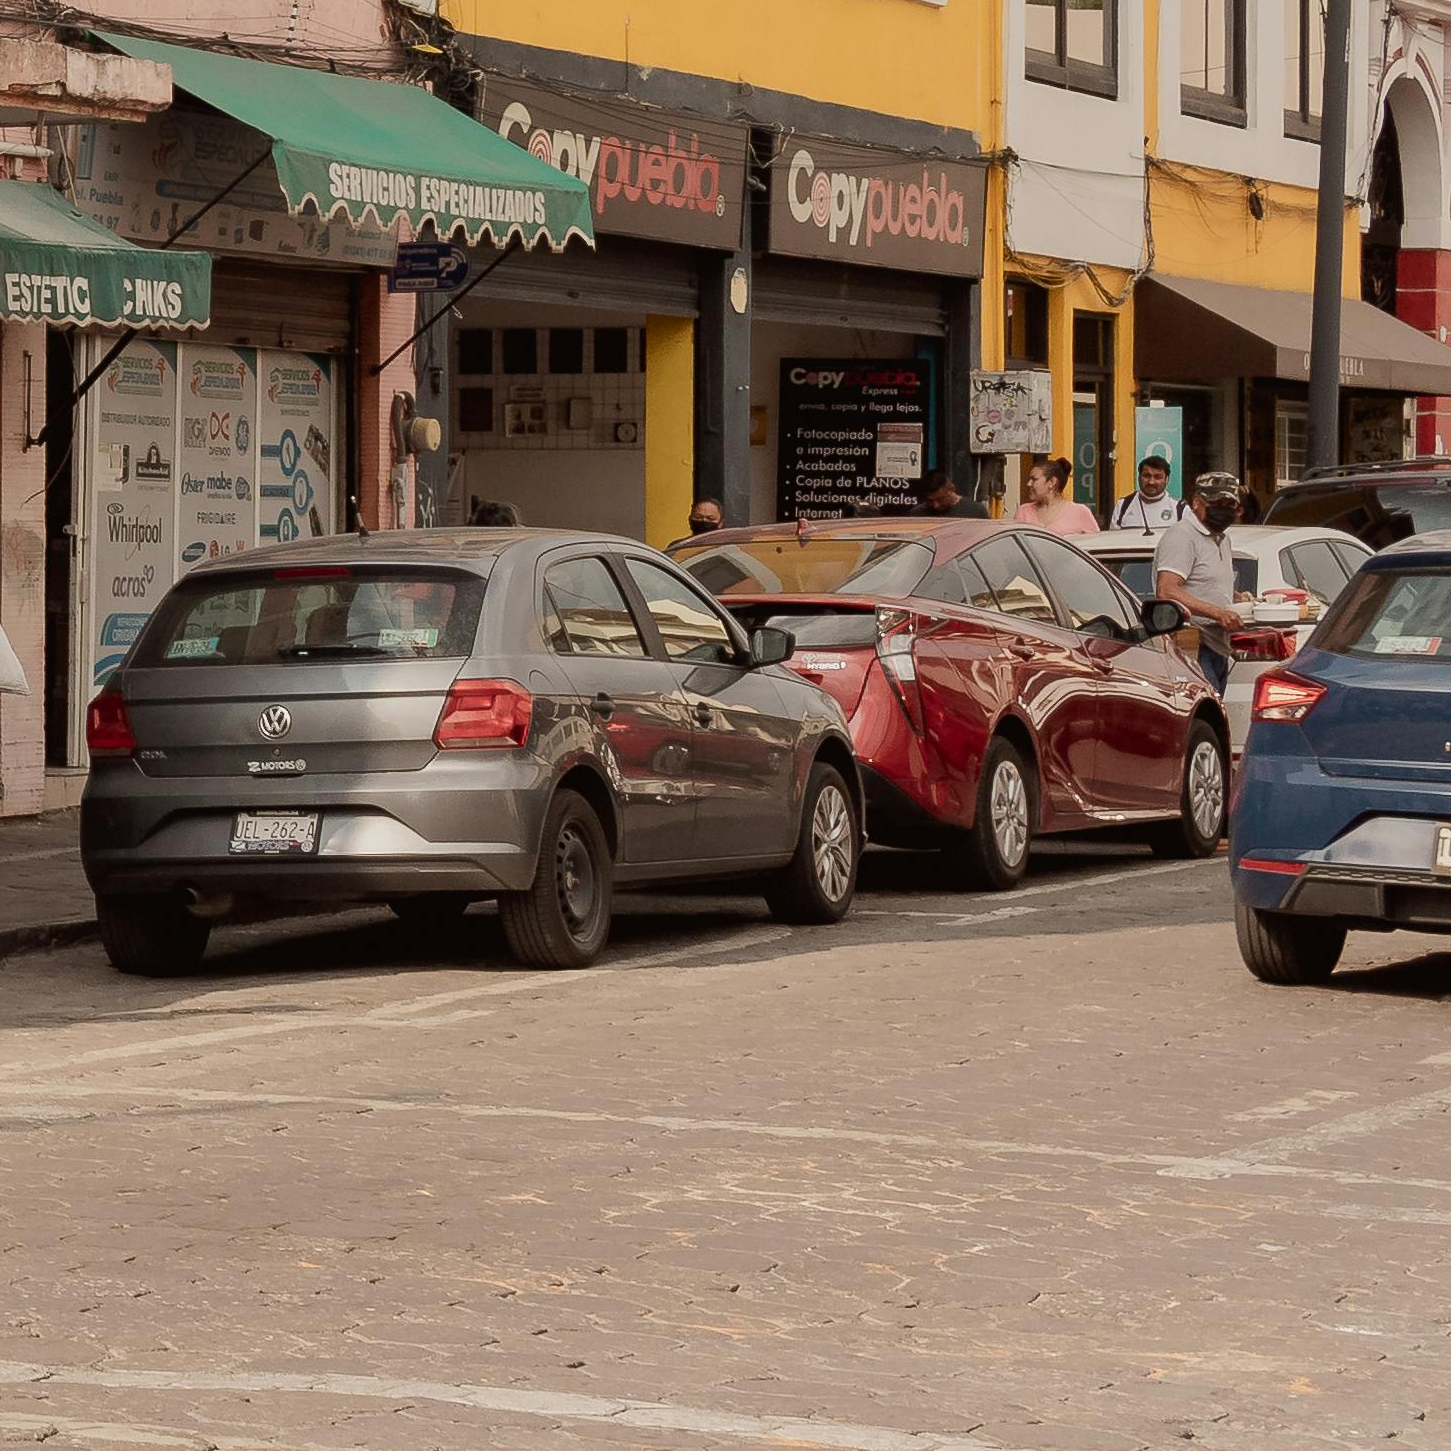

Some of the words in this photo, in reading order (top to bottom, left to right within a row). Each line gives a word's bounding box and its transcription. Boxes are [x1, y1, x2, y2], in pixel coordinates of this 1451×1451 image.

[328, 161, 416, 210] SERVICIOS
[419, 177, 547, 225] ESPECIALIZADOS
[5, 271, 92, 315] ESTETIC
[122, 276, 183, 321] CHIKS
[862, 386, 898, 396] Express
[796, 428, 874, 444] Fotocopiado
[807, 443, 869, 457] impresión
[796, 460, 856, 472] Acabados
[206, 471, 232, 490] mabe
[795, 475, 833, 490] Copia
[856, 476, 910, 490] PLANOS
[864, 493, 918, 508] digitales
[196, 511, 236, 526] FRIGIDAIRE
[794, 507, 843, 520] Internet
[108, 515, 162, 550] Whirlpool
[112, 577, 146, 598] acros
